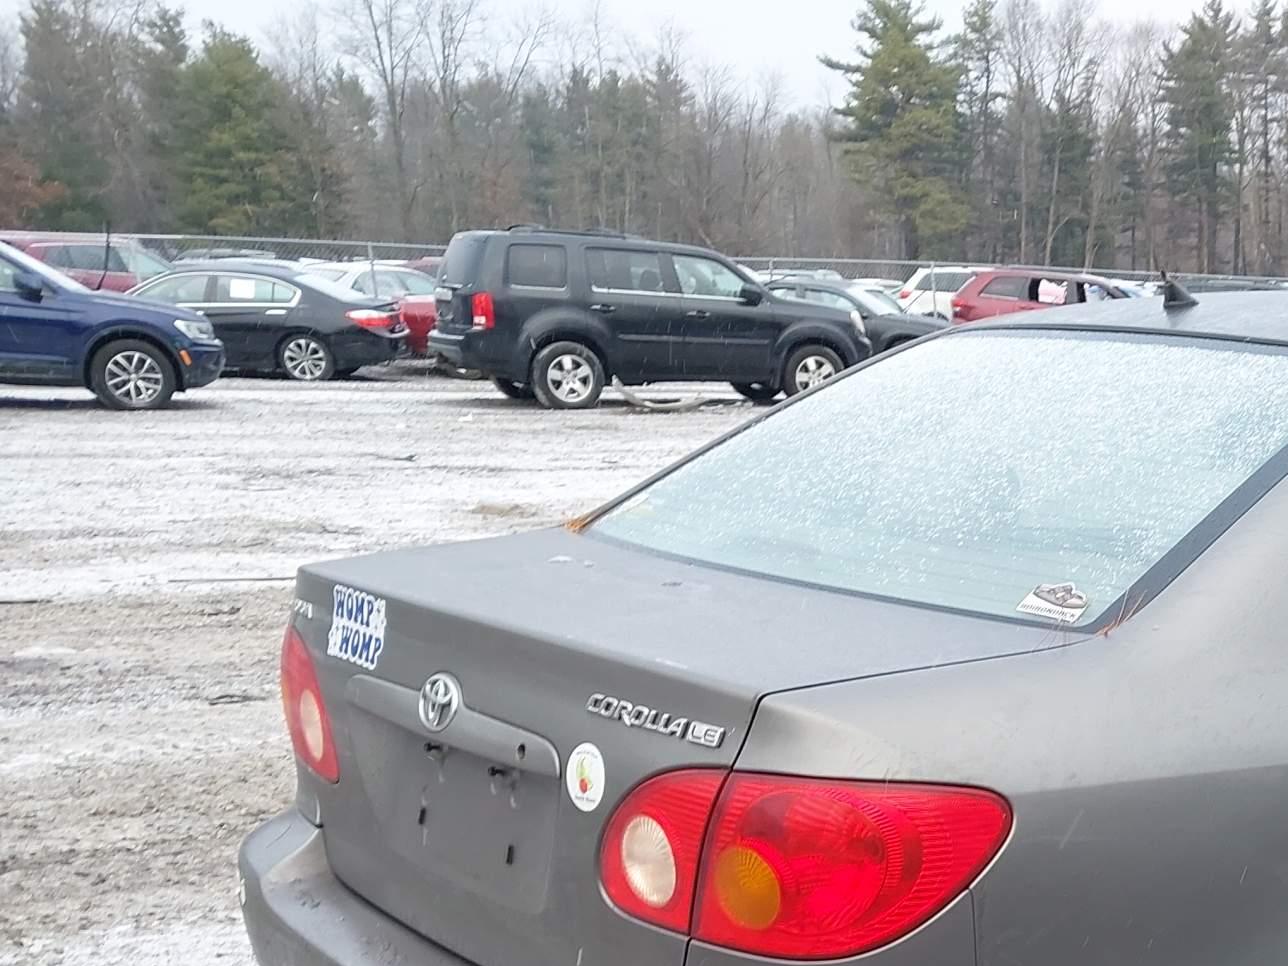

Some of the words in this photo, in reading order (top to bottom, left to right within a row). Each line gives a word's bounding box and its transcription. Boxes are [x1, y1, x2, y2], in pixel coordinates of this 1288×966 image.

[335, 588, 375, 628] WOMP
[339, 625, 382, 665] WOMP
[586, 692, 690, 738] COROLLA
[688, 722, 724, 746] LE
